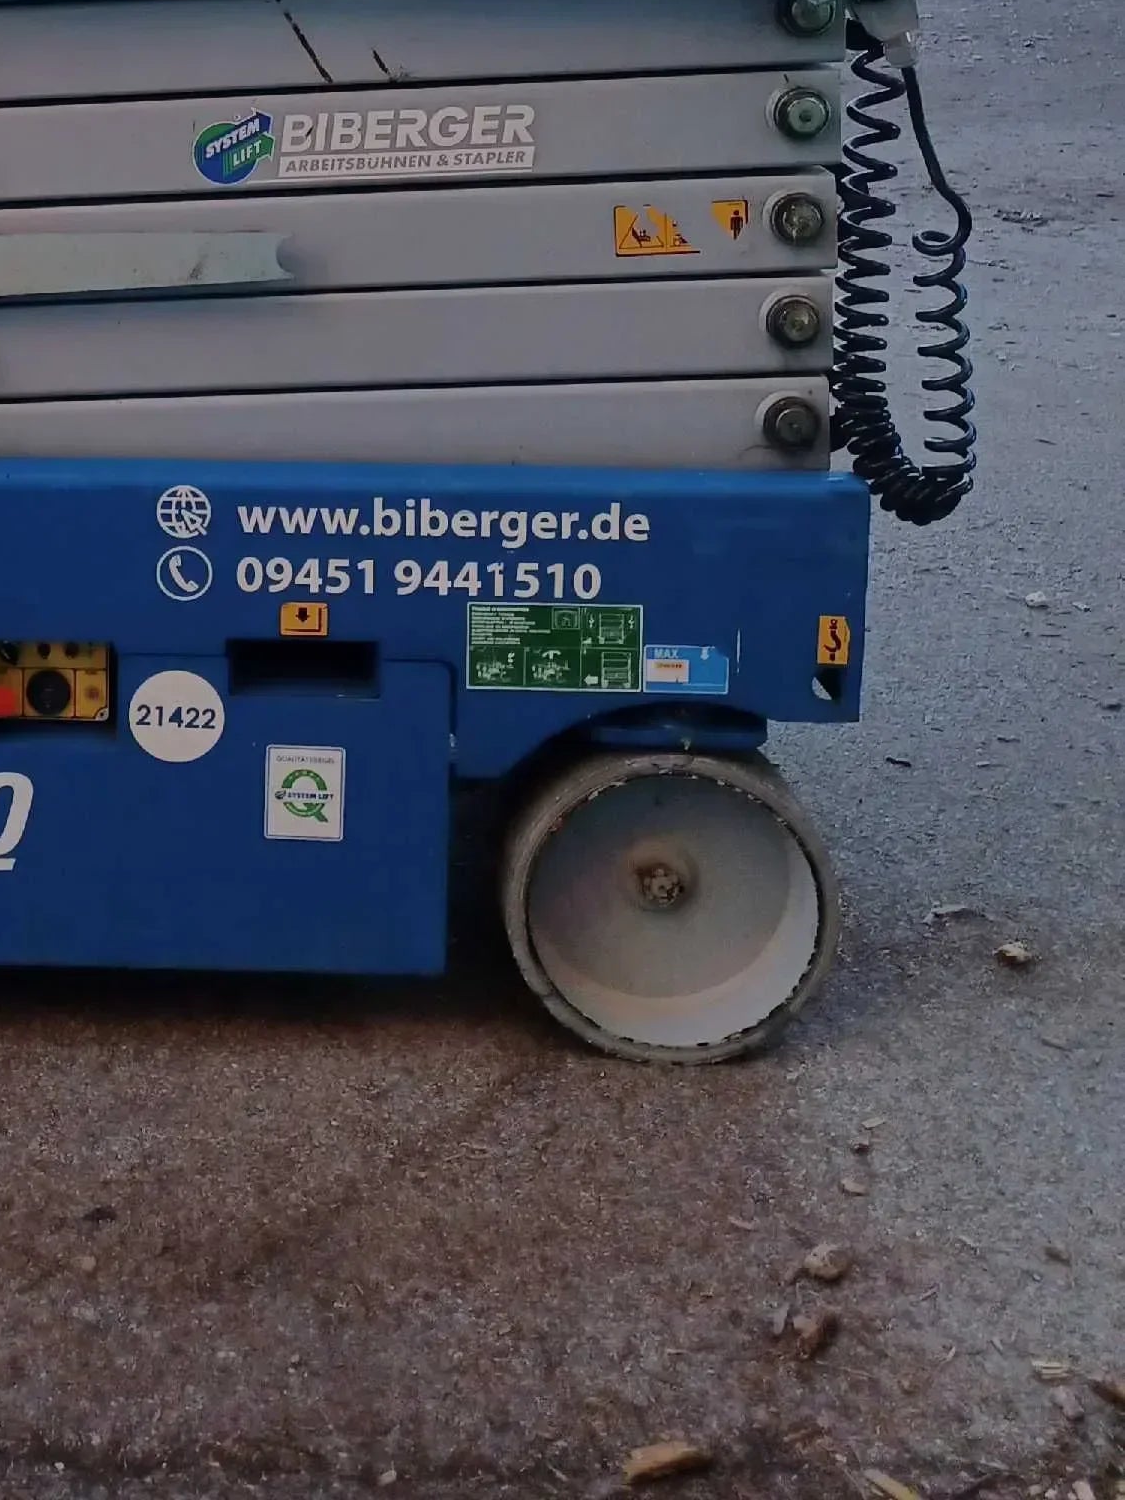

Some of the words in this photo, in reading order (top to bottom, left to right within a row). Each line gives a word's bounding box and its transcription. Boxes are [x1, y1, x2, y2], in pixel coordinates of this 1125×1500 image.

[205, 118, 260, 159] SYSTEM
[280, 104, 535, 153] BIBERGER
[233, 140, 262, 167] LIFT
[436, 153, 449, 167] &
[453, 151, 526, 167] STAPLER
[237, 497, 651, 549] www.biberger.de
[236, 556, 376, 595] 09451
[394, 559, 603, 600] 9441510
[654, 648, 680, 660] MAX
[135, 704, 217, 730] 21422
